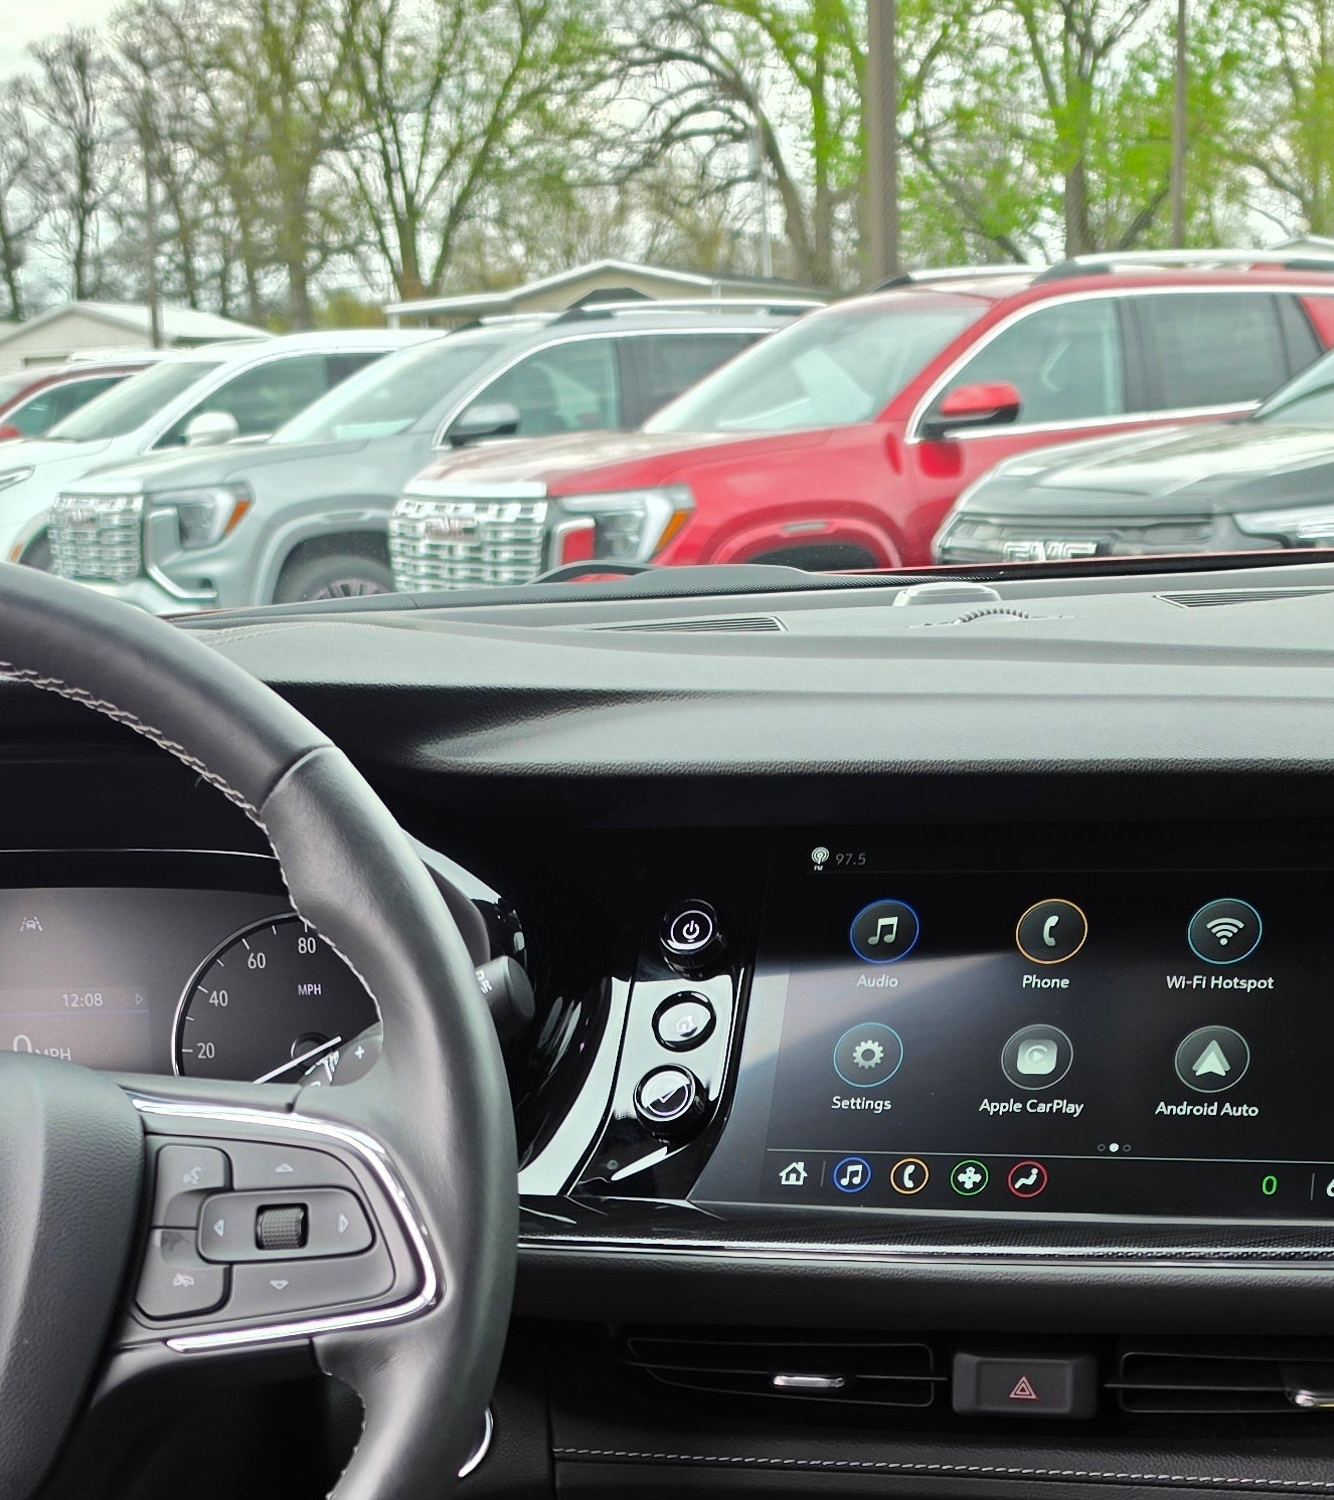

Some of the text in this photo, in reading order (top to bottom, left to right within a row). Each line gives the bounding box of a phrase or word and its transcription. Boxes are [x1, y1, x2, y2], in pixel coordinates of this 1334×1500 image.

[836, 853, 866, 866] 97.5
[298, 937, 316, 954] 80
[247, 952, 266, 969] 60
[298, 984, 322, 995] MPH
[856, 974, 899, 988] Audio
[1022, 974, 1070, 988] Phone
[1166, 975, 1274, 992] Wi-Fi Hotspot
[62, 993, 104, 1007] 12:08
[209, 990, 228, 1007] 40
[197, 1042, 215, 1059] 20
[831, 1096, 892, 1113] Settings
[978, 1099, 1084, 1117] Apple CarPlay
[1155, 1101, 1259, 1117] Android Auto
[1261, 1175, 1278, 1195] 0
